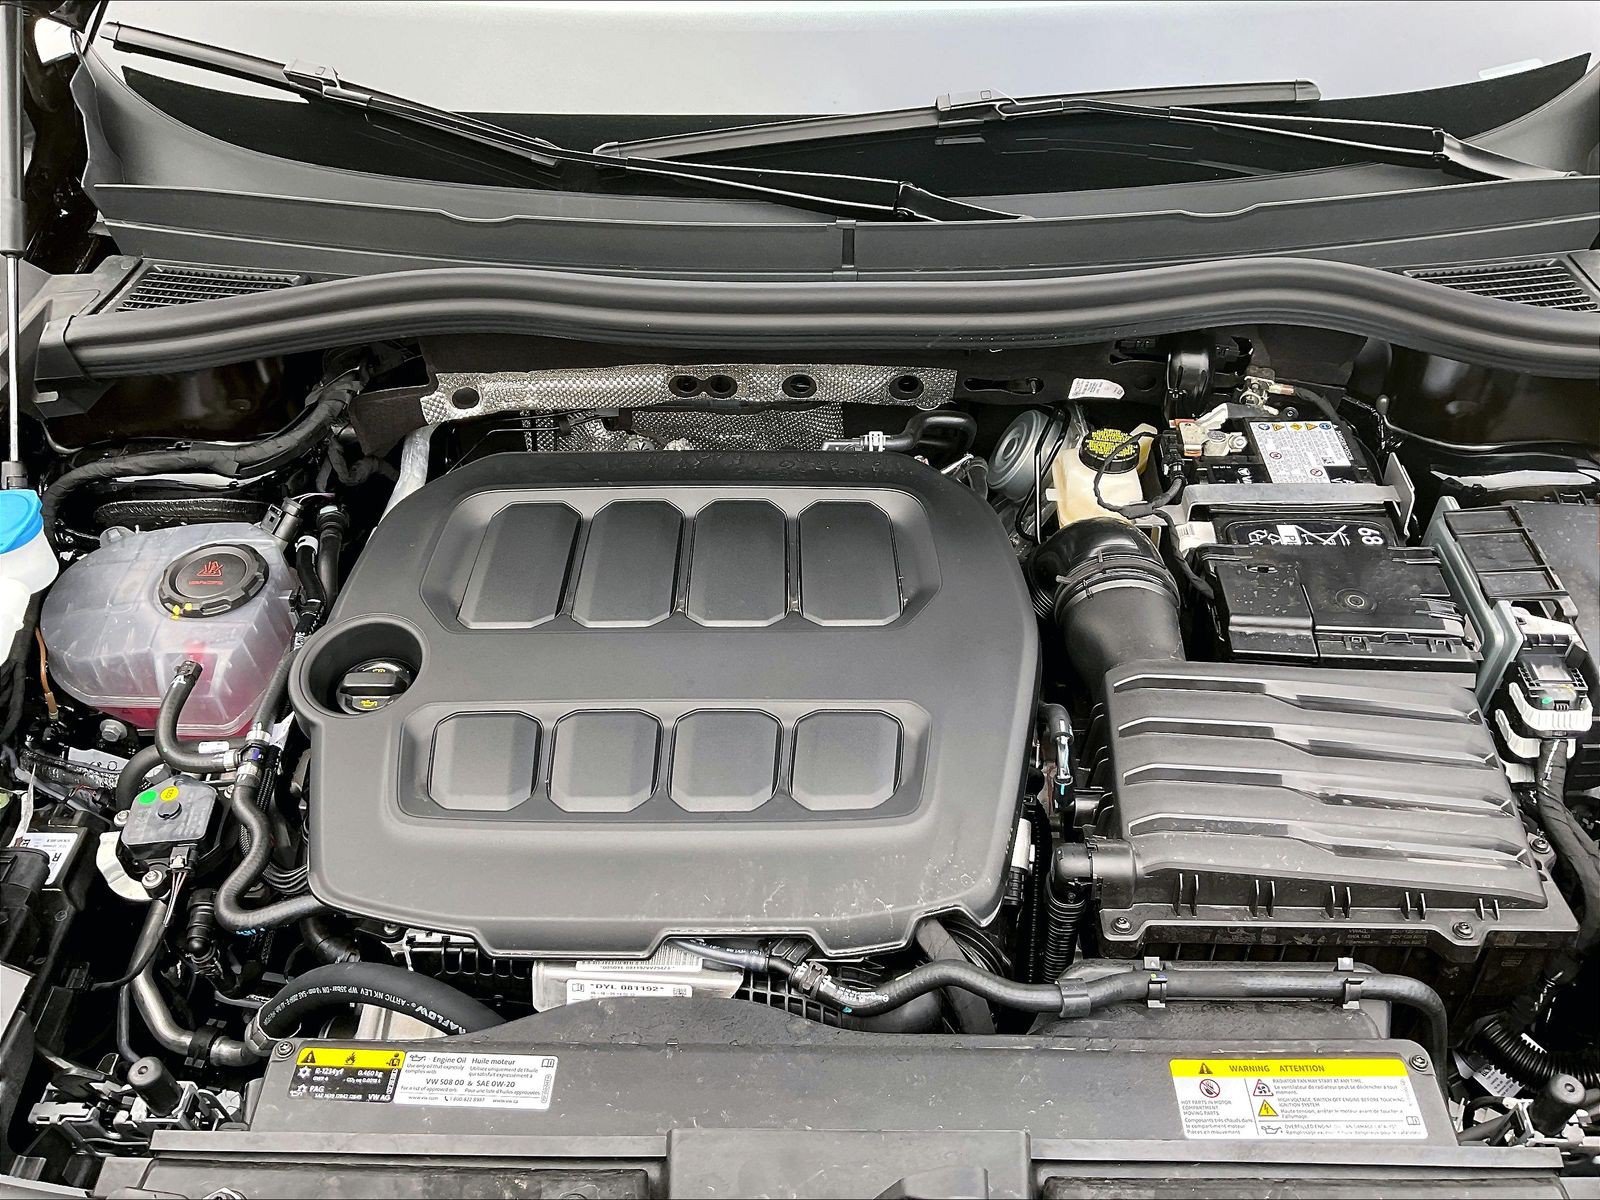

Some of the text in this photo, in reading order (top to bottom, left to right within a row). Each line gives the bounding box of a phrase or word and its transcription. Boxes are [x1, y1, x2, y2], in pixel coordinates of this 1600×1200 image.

[1358, 527, 1383, 545] 68
[52, 852, 62, 862] R
[348, 986, 359, 994] WP
[360, 987, 373, 997] LEV
[373, 990, 384, 1000] NK
[384, 993, 407, 1006] ARTIC
[432, 1056, 455, 1065] Engine
[471, 1057, 490, 1065] Huile
[490, 1058, 516, 1066] moteur
[314, 1067, 344, 1077] R-1234yf
[1228, 1064, 1325, 1072] WARNING ATTENTION
[425, 1078, 440, 1086] VW
[440, 1078, 454, 1086] 508
[491, 1080, 516, 1088] 0W-20
